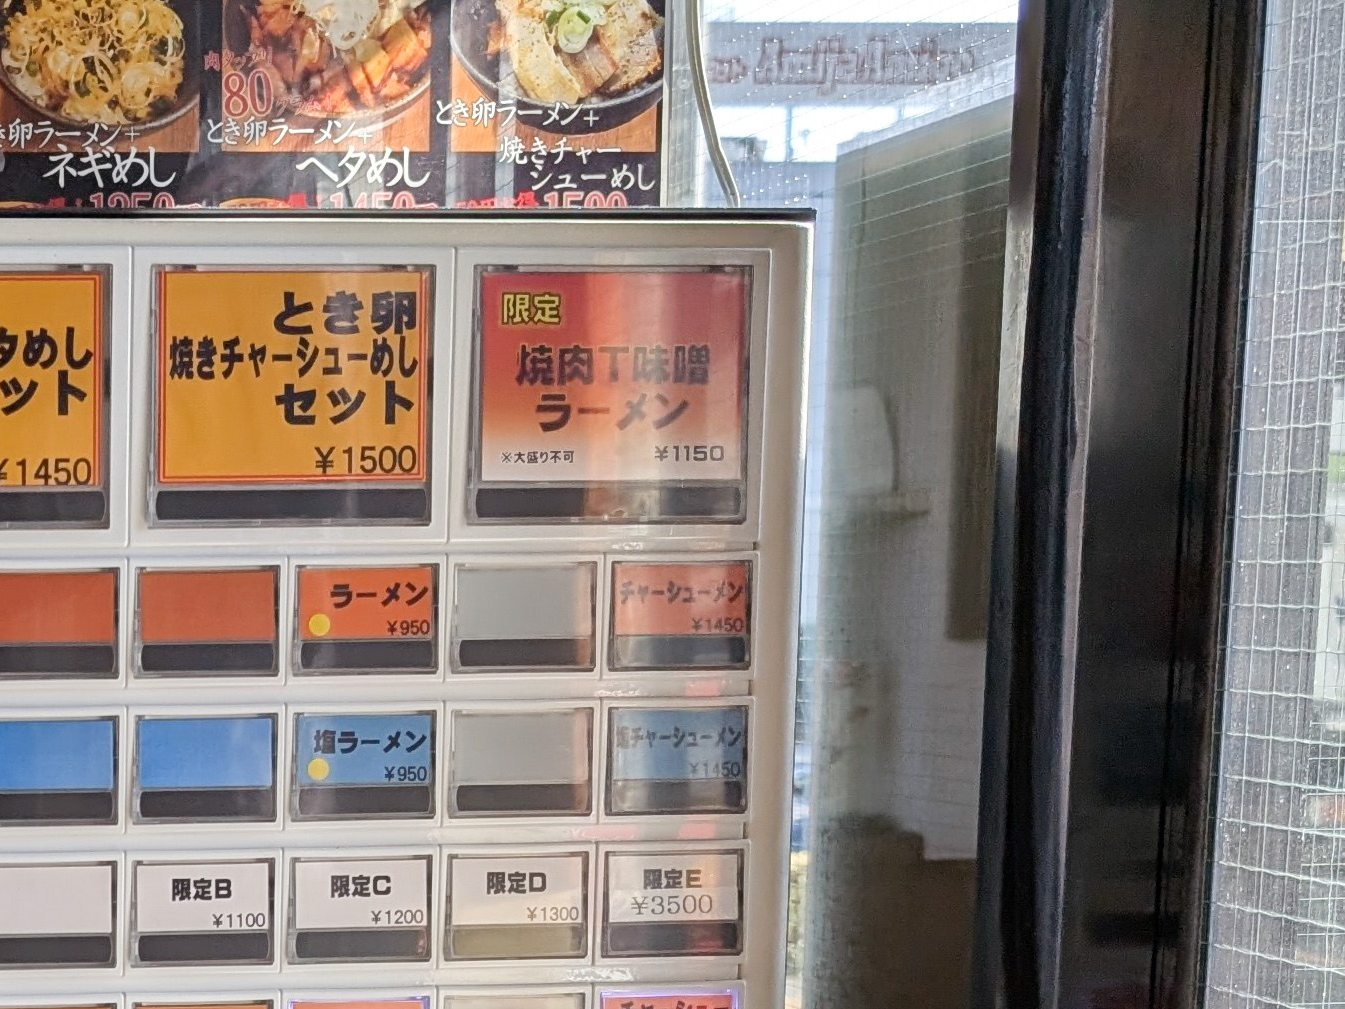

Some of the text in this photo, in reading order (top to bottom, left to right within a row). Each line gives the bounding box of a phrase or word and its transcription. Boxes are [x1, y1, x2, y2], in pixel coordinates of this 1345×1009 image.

[43, 145, 176, 188] ネギめし
[273, 291, 416, 334] とき卵
[502, 292, 561, 325] 限定
[170, 336, 418, 379] 焼きチャーシューめし
[275, 380, 415, 425] セット
[536, 393, 689, 432] ラーメン
[315, 445, 416, 473] ¥1500
[655, 445, 724, 462] ¥1150
[330, 582, 429, 608] ラーメン
[387, 619, 429, 636] ¥950
[314, 728, 428, 755] 塩ラーメン
[384, 766, 427, 782] ¥950
[171, 877, 232, 901] 限定B
[330, 874, 392, 899] 限定C
[486, 870, 547, 895] 限定D
[642, 867, 702, 891] 限定E
[212, 912, 265, 929] ¥1100
[371, 909, 423, 925] ¥1200
[527, 906, 579, 922] ¥1300
